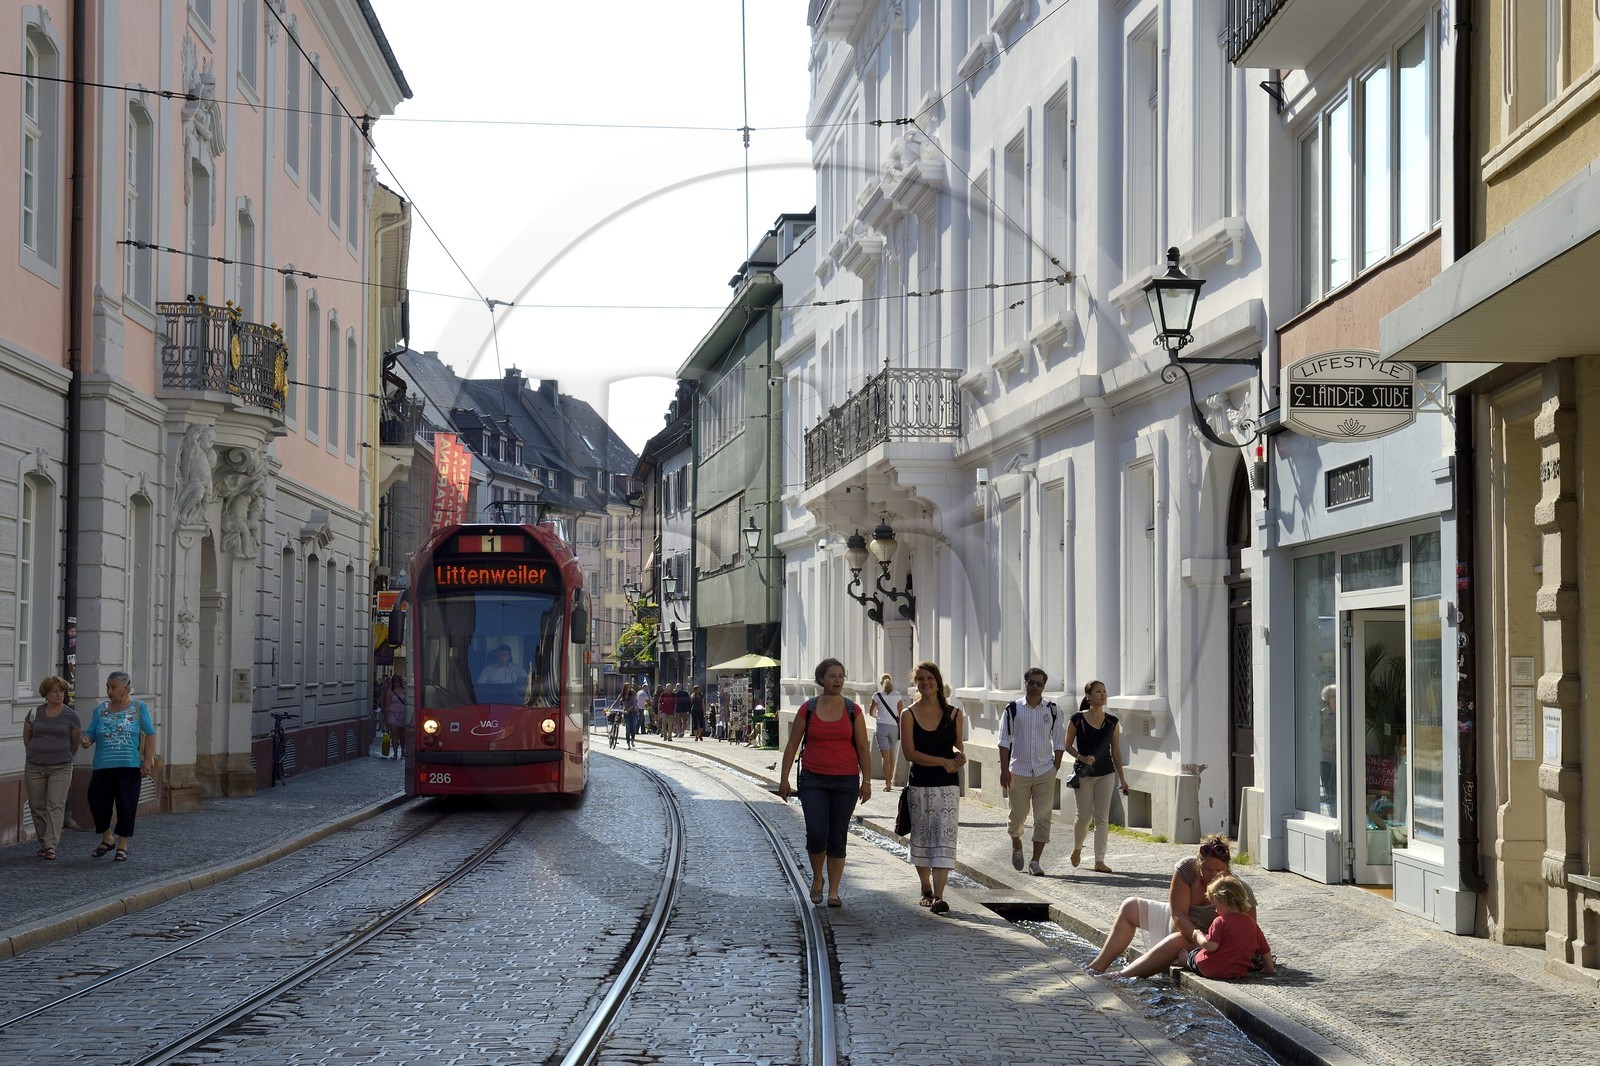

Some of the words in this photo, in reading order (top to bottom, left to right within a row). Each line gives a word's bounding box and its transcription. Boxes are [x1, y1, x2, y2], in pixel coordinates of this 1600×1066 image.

[1301, 356, 1403, 379] LIFESTYLE
[1294, 385, 1365, 407] 2-LÄNDER
[1371, 387, 1409, 407] STUBE
[487, 537, 495, 552] 1
[437, 565, 547, 585] Littenweiler
[480, 720, 499, 728] VAG
[429, 773, 452, 784] 286
